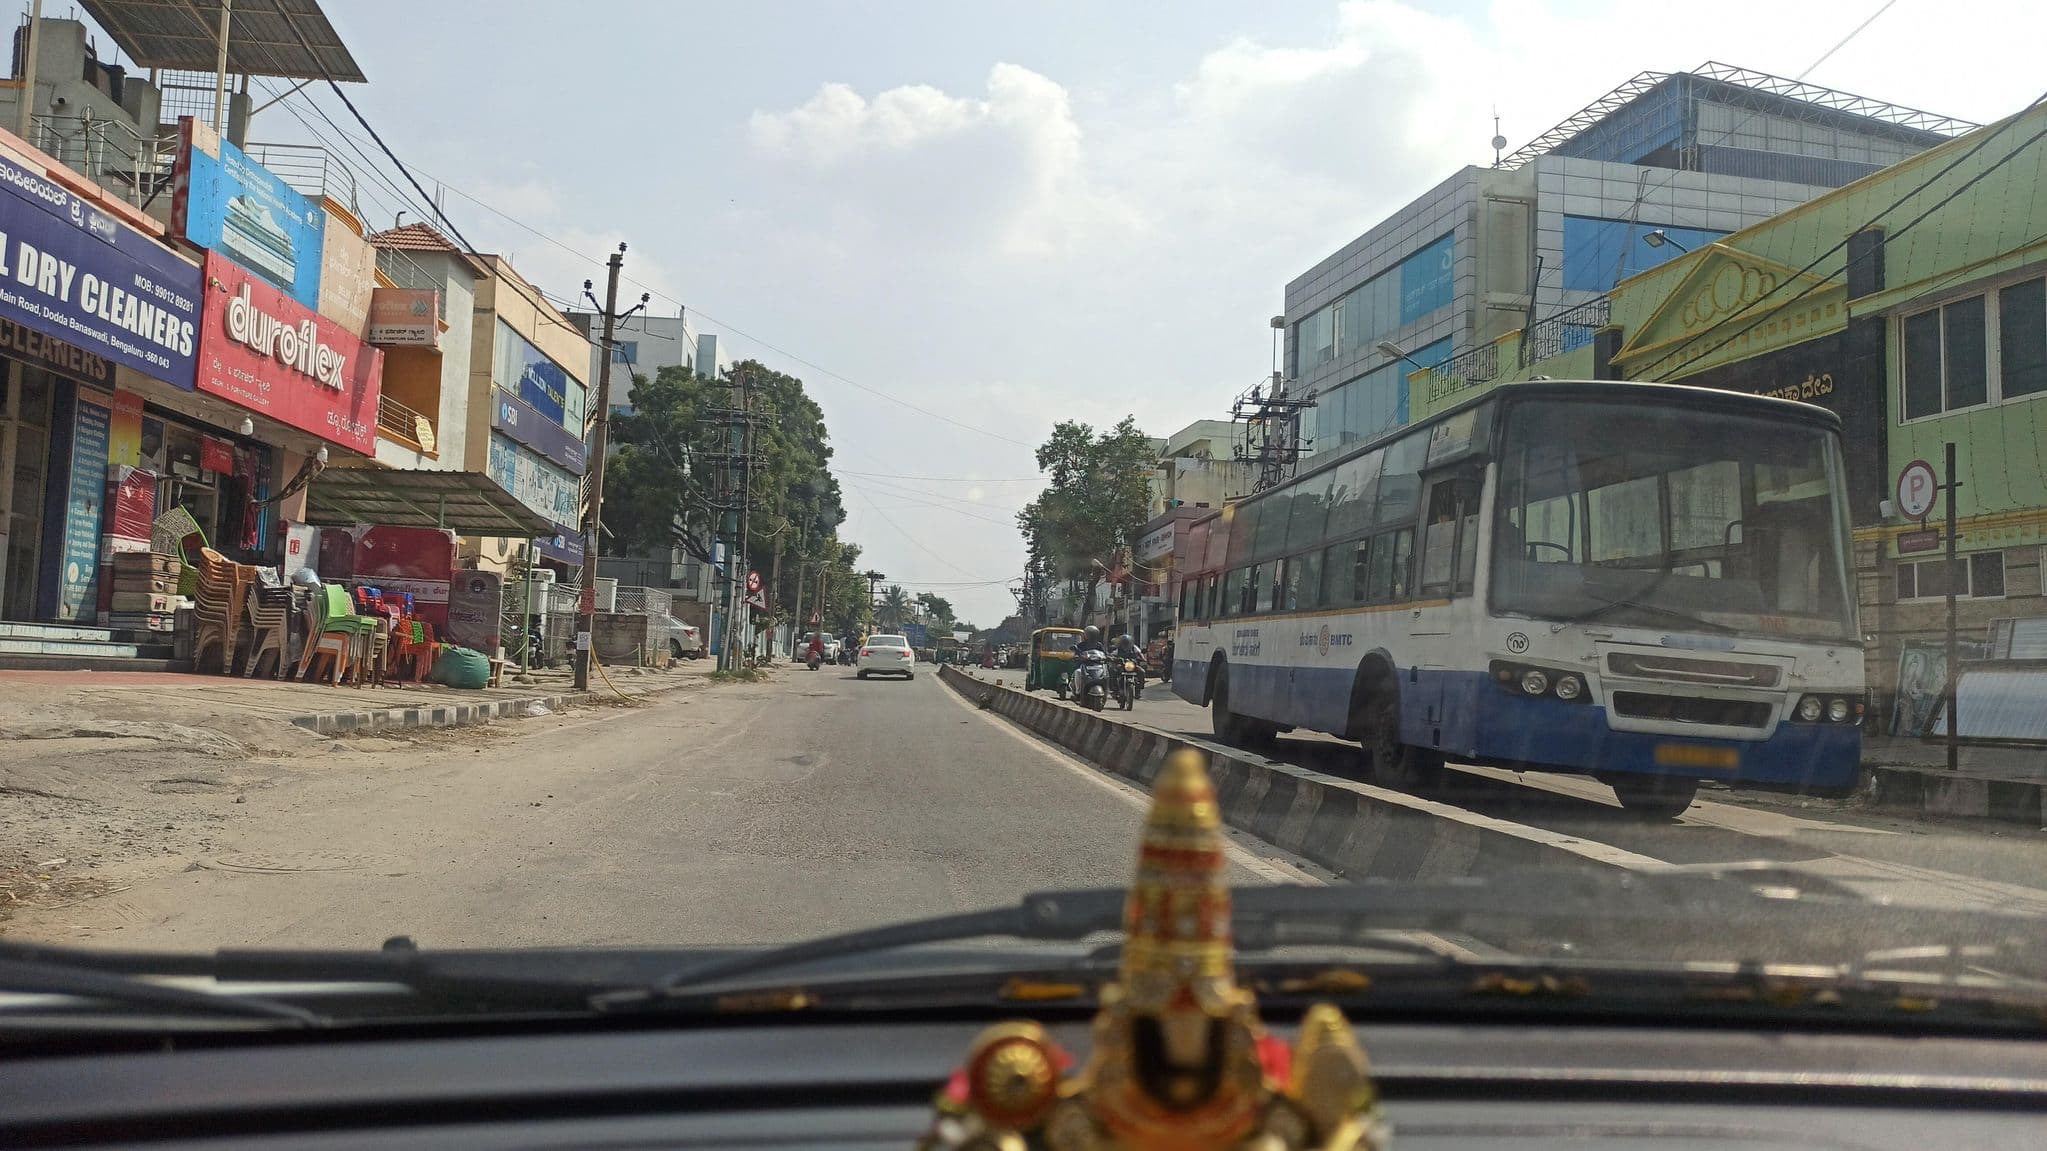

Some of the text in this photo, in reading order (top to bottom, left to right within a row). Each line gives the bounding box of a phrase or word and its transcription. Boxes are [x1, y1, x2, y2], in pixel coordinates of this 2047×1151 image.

[134, 274, 154, 294] MOB:
[17, 241, 76, 303] DRY
[80, 273, 194, 357] CLEANERS
[18, 296, 41, 317] Road,
[43, 306, 68, 326] Dodda
[69, 317, 109, 345] Banaswadi,
[110, 335, 144, 358] Bengaluru
[224, 282, 346, 391] duroflex
[507, 406, 518, 427] SBI
[1911, 474, 1925, 502] P
[1330, 633, 1353, 647] BMTC
